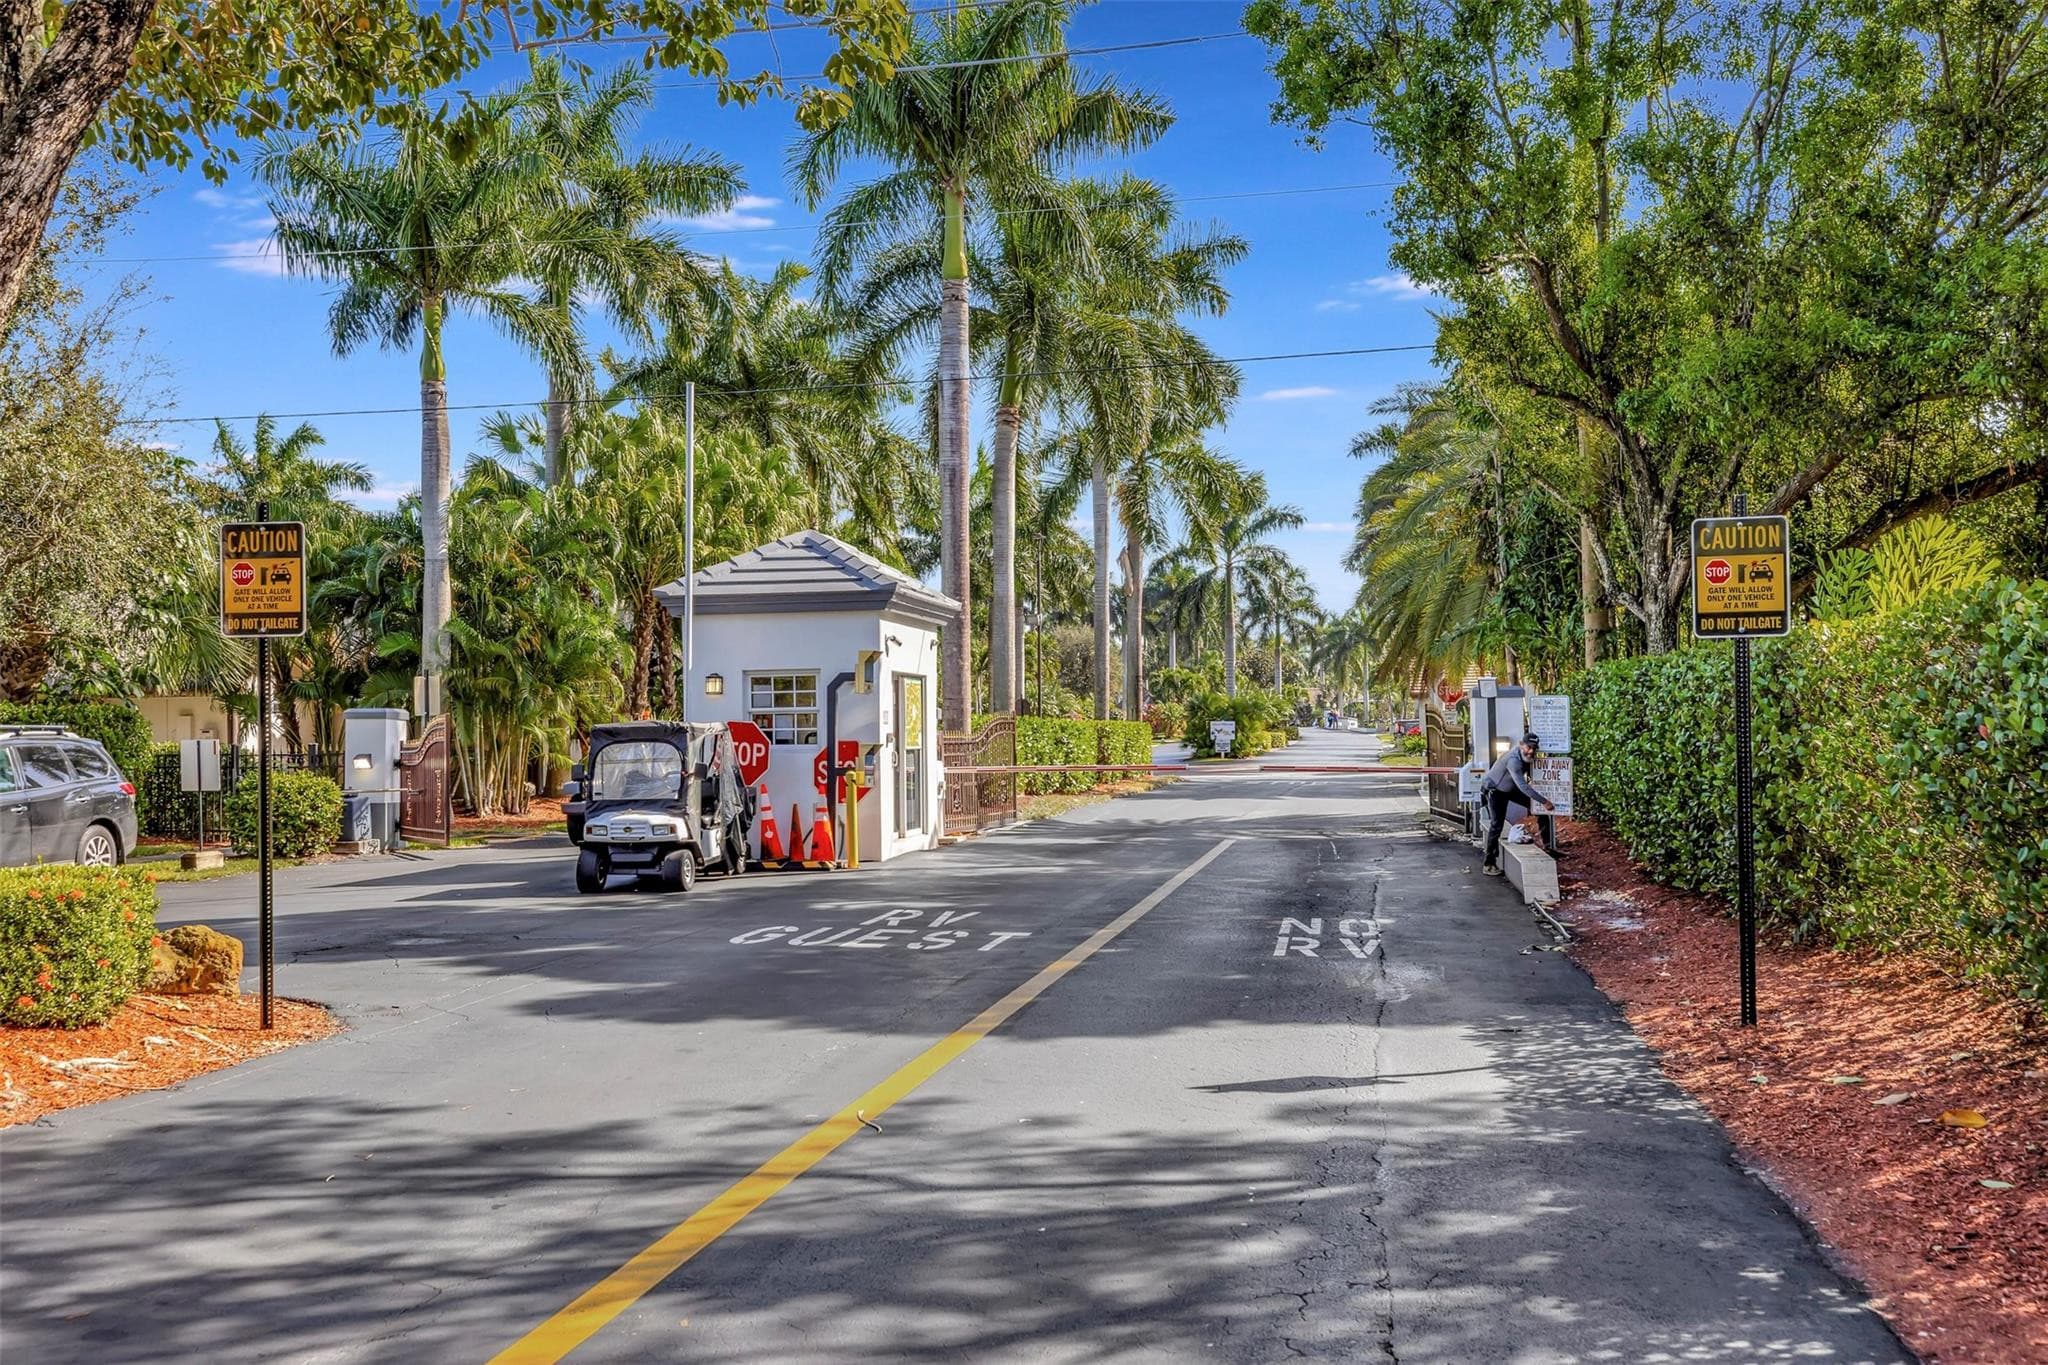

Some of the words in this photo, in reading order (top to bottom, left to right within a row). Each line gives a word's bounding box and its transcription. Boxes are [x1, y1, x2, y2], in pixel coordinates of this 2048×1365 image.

[227, 530, 298, 552] CAUTION
[1700, 525, 1780, 550] CAUTION
[232, 569, 254, 579] STOP
[1706, 567, 1729, 577] STOP
[228, 619, 239, 630] DO
[241, 618, 259, 629] NOT
[260, 617, 298, 629] TAILGATE
[1701, 618, 1714, 630] DO
[1717, 617, 1736, 629] NOT
[1738, 616, 1782, 629] TAILGATE
[1533, 760, 1549, 770] TOW
[1551, 760, 1570, 770] AWAY
[1542, 770, 1560, 780] ZONE
[858, 908, 982, 928] RV
[1278, 917, 1380, 937] NO
[728, 925, 1032, 951] GUEST
[1273, 936, 1380, 958] RV
